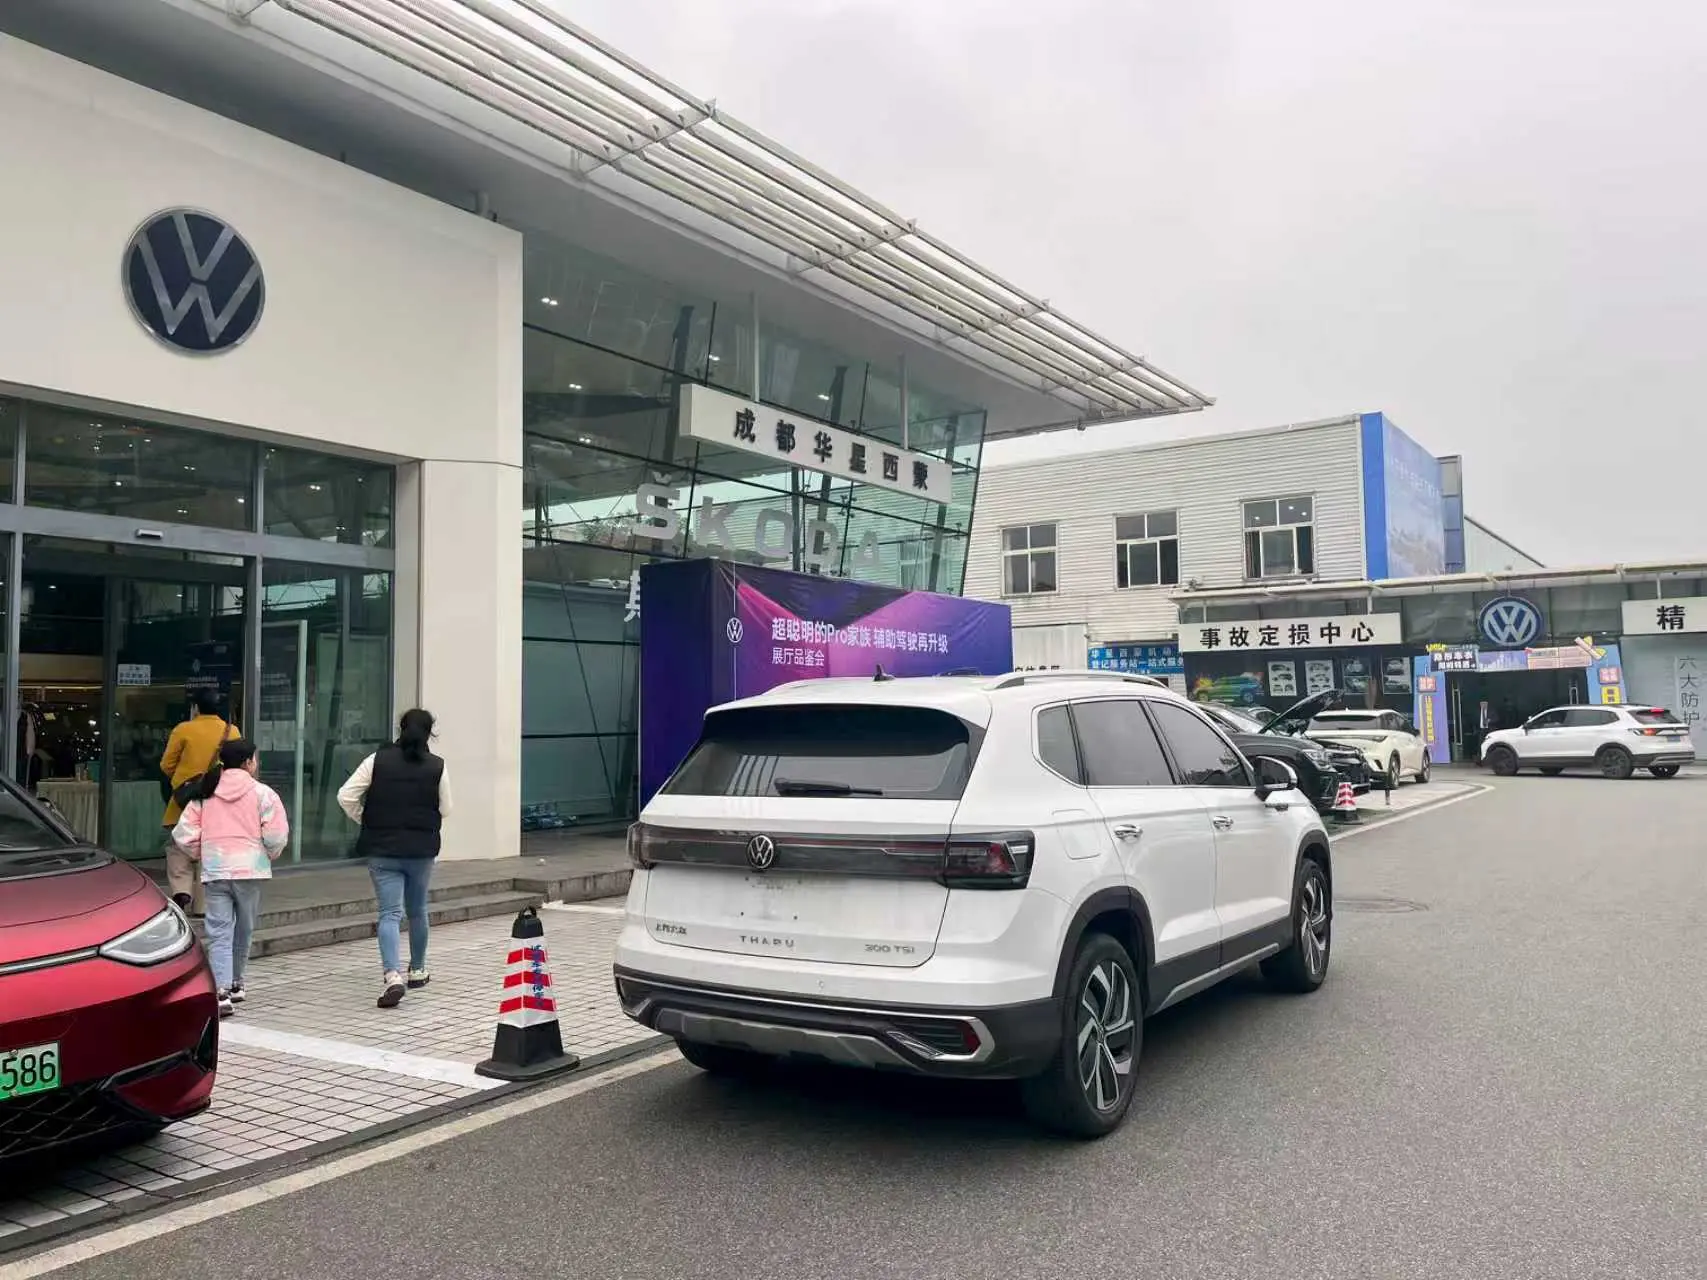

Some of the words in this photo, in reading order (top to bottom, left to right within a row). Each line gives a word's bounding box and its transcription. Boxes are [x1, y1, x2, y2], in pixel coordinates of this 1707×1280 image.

[733, 407, 930, 492] 成都华星西蒙
[1656, 605, 1686, 631] 精
[771, 617, 872, 648] 超聪明的Pro家族
[873, 626, 949, 654] 辅助驾驶再升级
[1200, 621, 1375, 649] 事故定损中心
[771, 647, 825, 666] 展厅品鉴会
[1679, 655, 1700, 726] 六大防护
[864, 943, 892, 953] 300
[893, 944, 916, 955] TSI
[1, 1050, 56, 1091] 586
